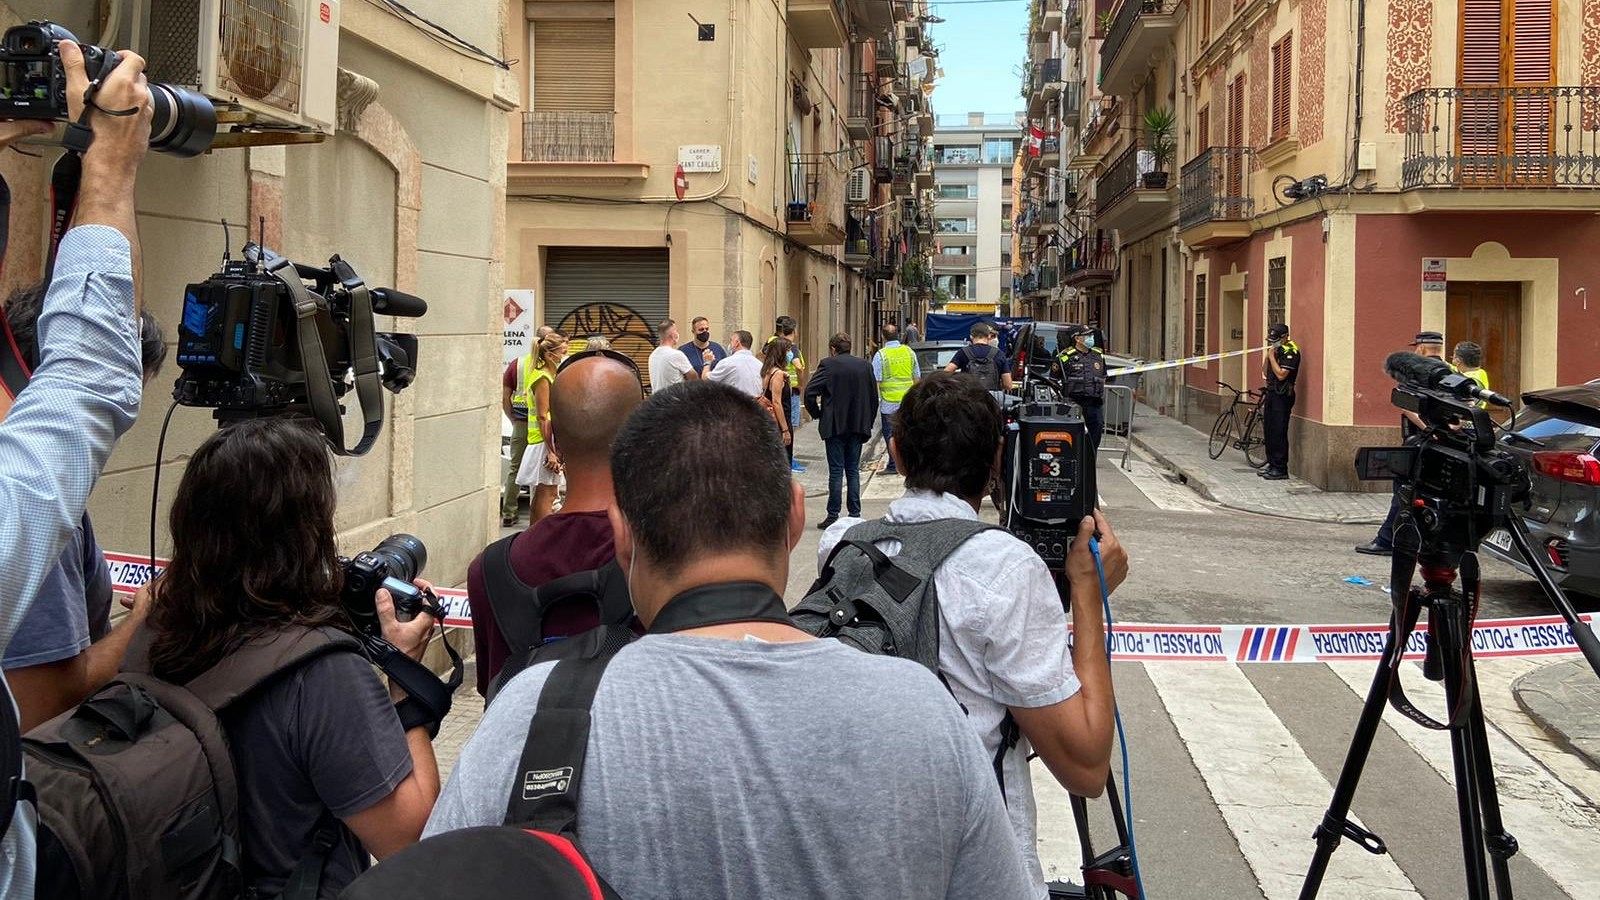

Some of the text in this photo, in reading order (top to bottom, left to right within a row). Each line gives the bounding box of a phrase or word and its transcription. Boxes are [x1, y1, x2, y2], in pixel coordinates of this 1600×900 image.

[1109, 633, 1144, 653] POLIC
[1154, 633, 1201, 654] PASSEU
[1205, 634, 1224, 654] NO
[1472, 627, 1512, 650] POLICI
